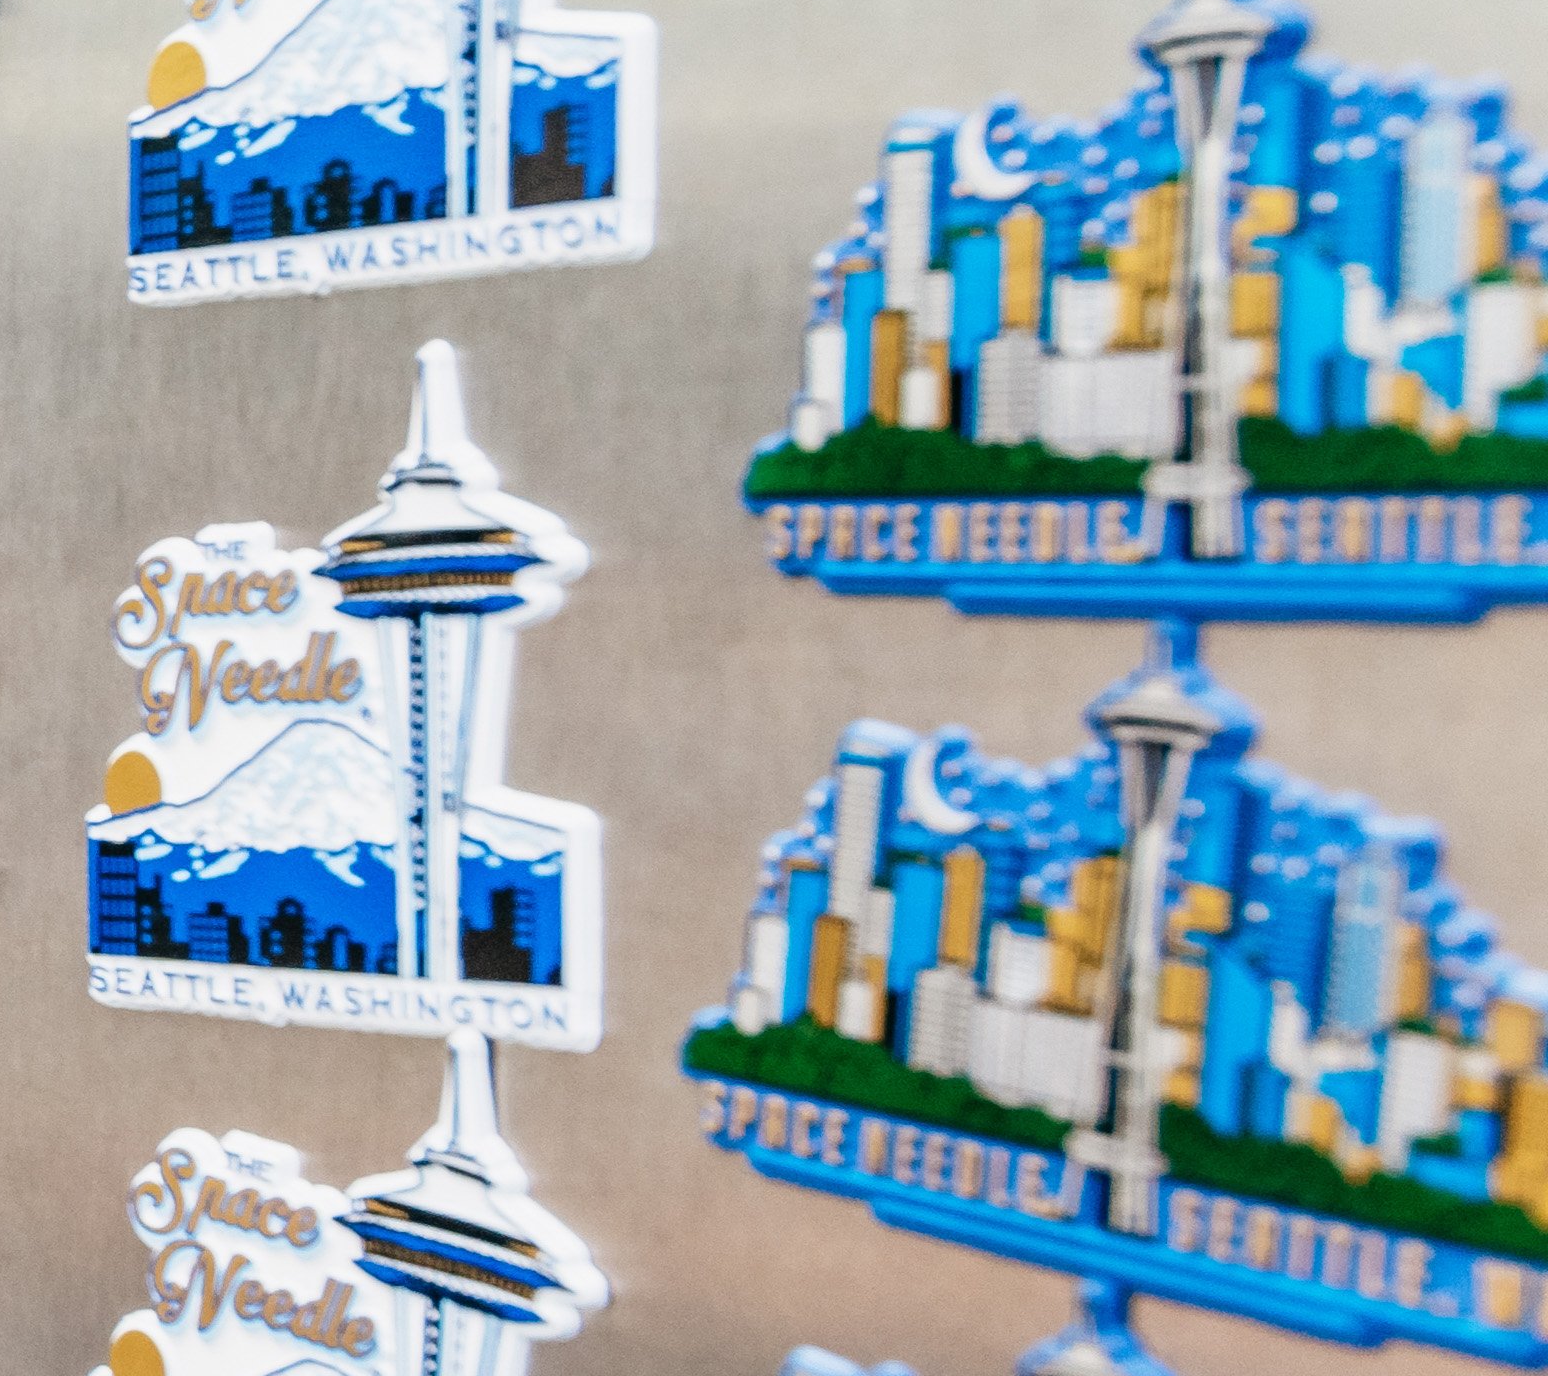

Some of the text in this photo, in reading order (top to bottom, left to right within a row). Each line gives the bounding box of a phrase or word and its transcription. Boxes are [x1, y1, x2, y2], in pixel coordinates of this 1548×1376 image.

[129, 208, 621, 293] SEATTLE, WASHINGTON
[763, 503, 923, 562] SPACE
[118, 558, 297, 649] Space
[140, 632, 360, 735] Needle
[90, 965, 567, 1032] SEATTLE, WASHINGTON
[699, 1078, 848, 1168] SPACE
[134, 1148, 320, 1249] Space
[148, 1241, 375, 1358] Needle
